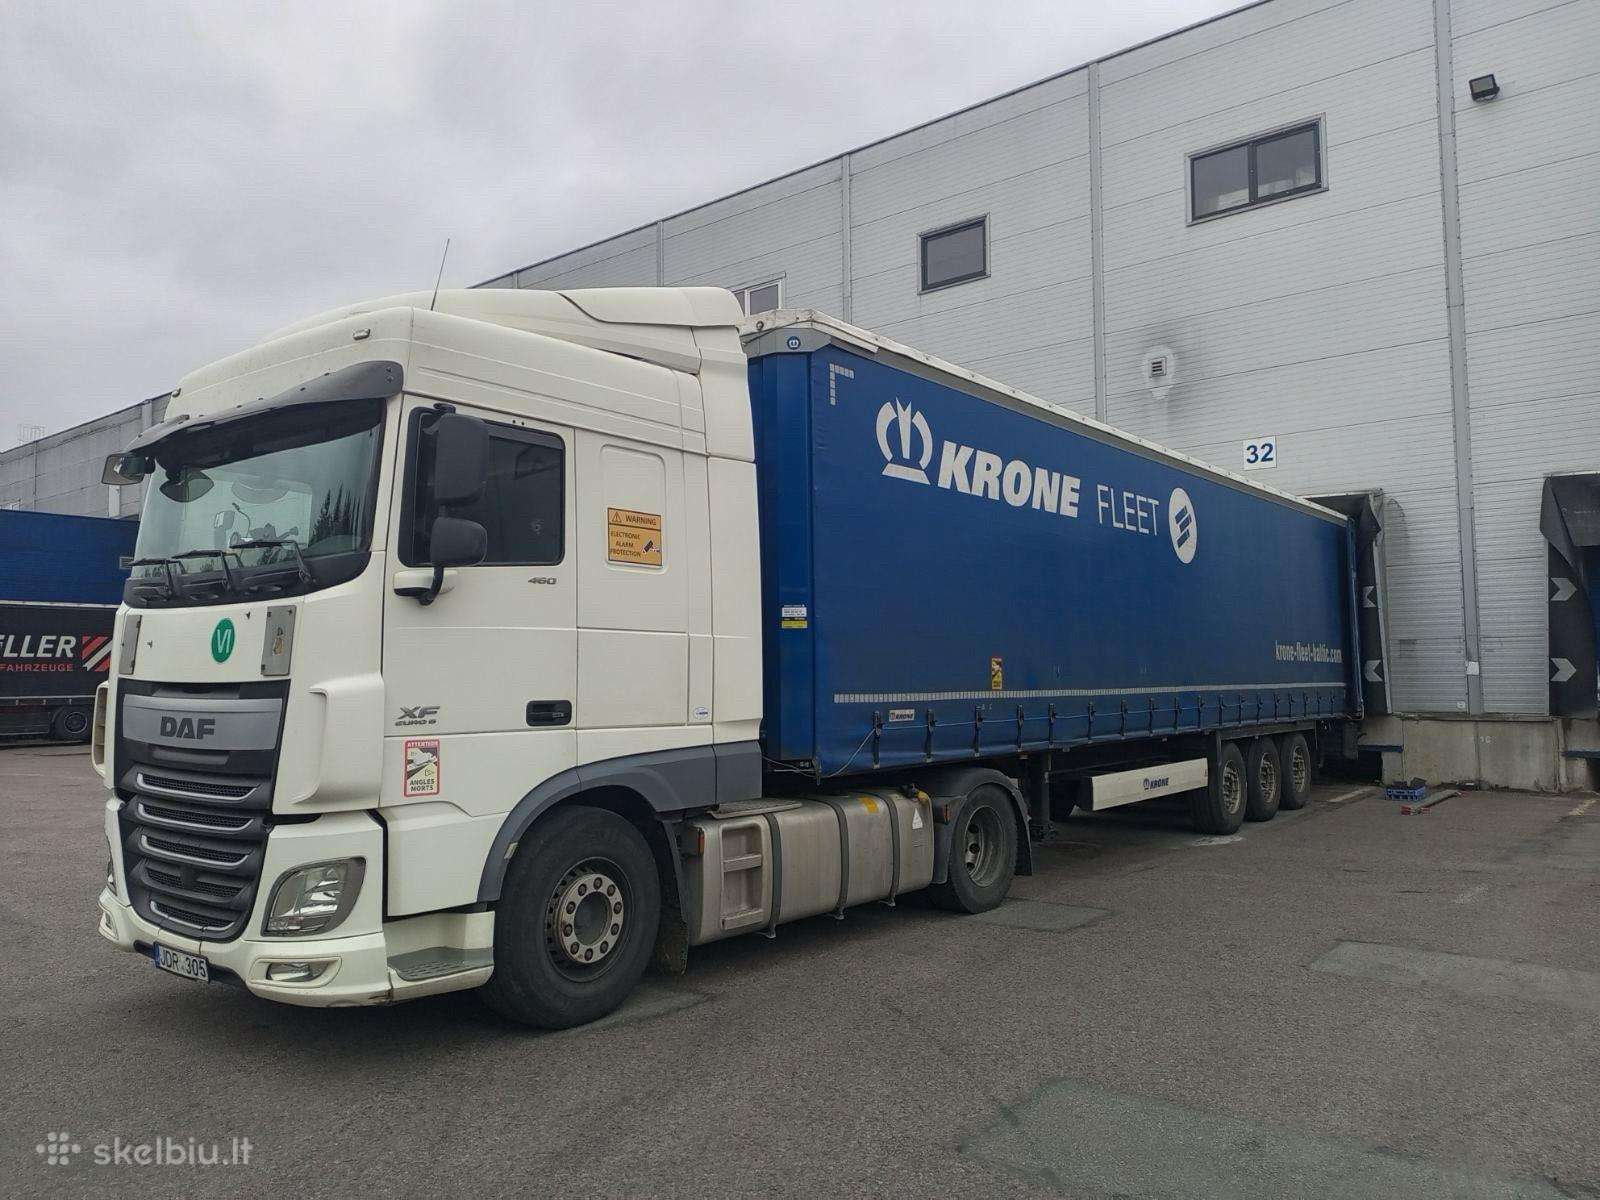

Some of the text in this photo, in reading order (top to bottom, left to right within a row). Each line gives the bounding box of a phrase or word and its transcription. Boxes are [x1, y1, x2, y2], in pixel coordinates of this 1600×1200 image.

[1246, 442, 1274, 464] 32
[937, 440, 1160, 536] KRONE FLEET
[625, 514, 657, 526] WARNING
[527, 577, 557, 585] 460
[397, 705, 441, 720] XF
[160, 716, 216, 740] DAF
[1149, 778, 1169, 789] KRONE
[160, 949, 207, 978] JDR 305
